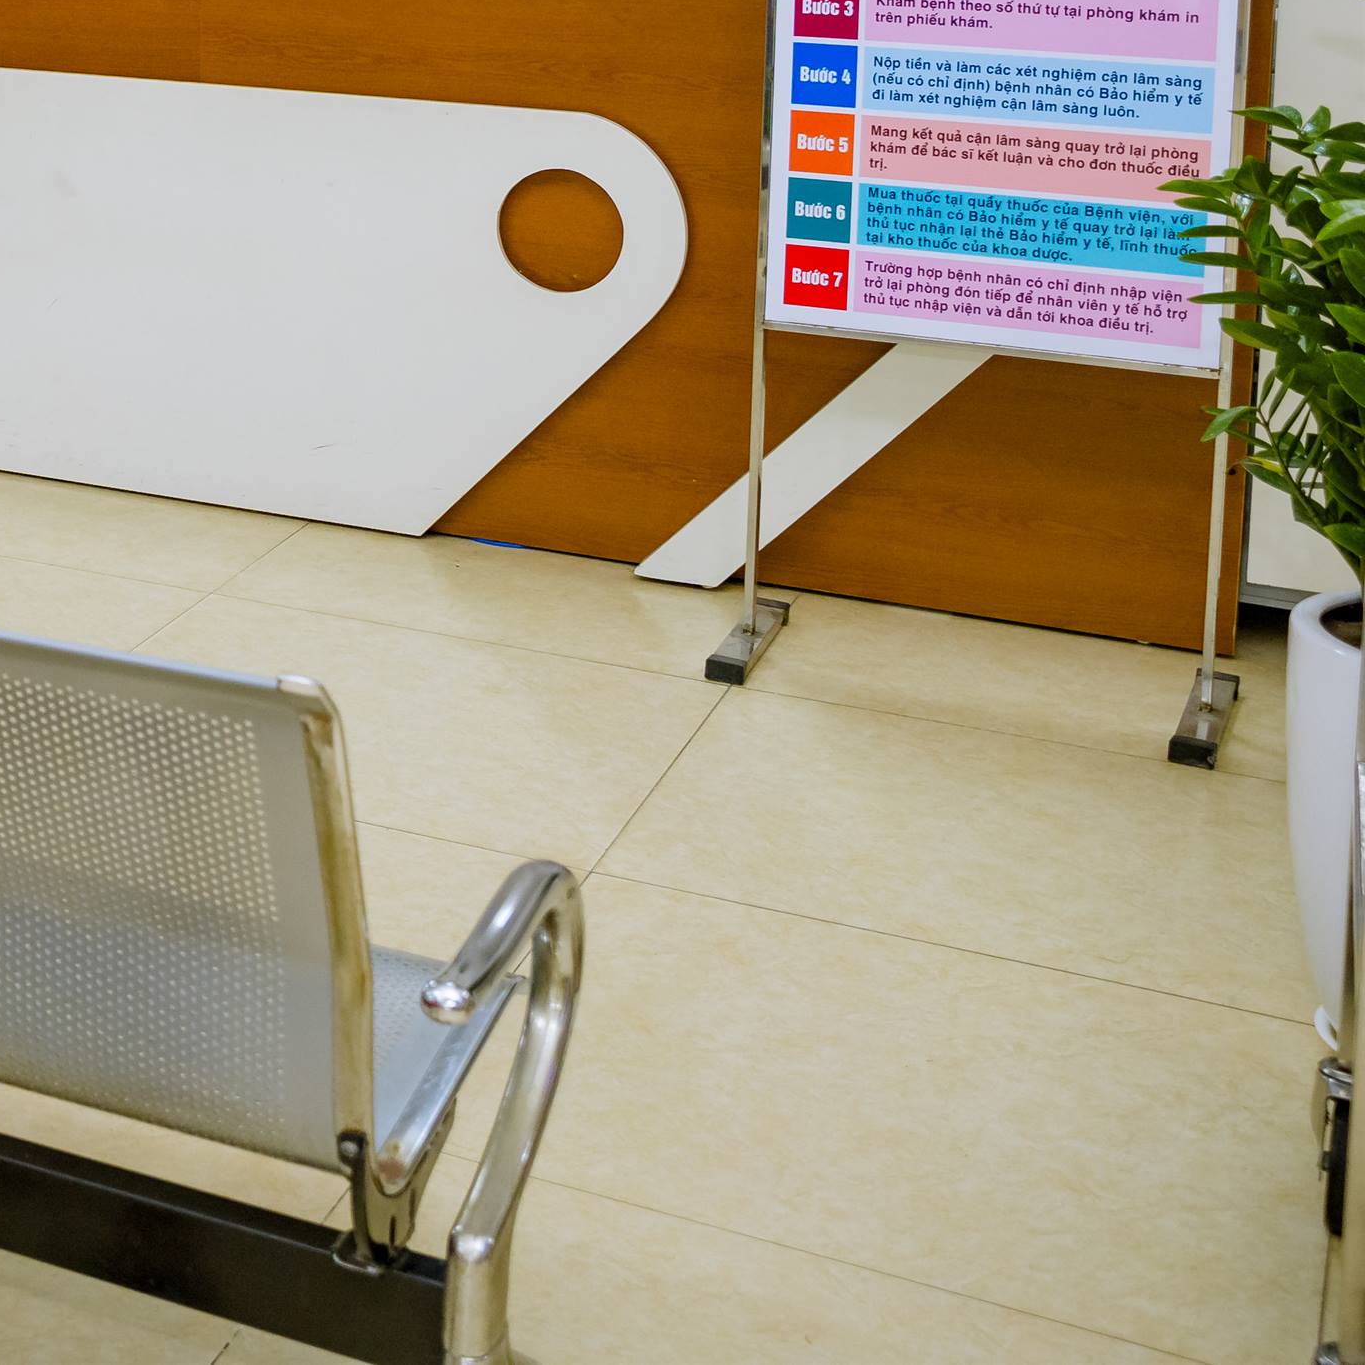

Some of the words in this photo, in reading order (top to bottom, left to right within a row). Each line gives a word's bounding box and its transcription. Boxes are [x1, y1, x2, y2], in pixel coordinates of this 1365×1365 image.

[843, 1, 854, 17] 3
[960, 0, 991, 11] theo
[996, 1, 1013, 13] số
[1017, 3, 1042, 14] thứ
[1045, 5, 1061, 18] tự
[1063, 5, 1081, 19] tại
[1087, 7, 1133, 23] phòng
[1139, 9, 1179, 22] khám
[1186, 11, 1199, 23] in
[875, 12, 902, 23] trên
[907, 13, 945, 27] phiếu
[951, 15, 993, 29] khám.
[799, 66, 838, 85] Bước
[840, 68, 851, 85] 4
[797, 133, 836, 152] Bước
[838, 137, 849, 153] 5
[794, 201, 833, 219] Bước
[835, 204, 846, 221] 6
[791, 267, 830, 286] Bước
[832, 271, 843, 288] 7
